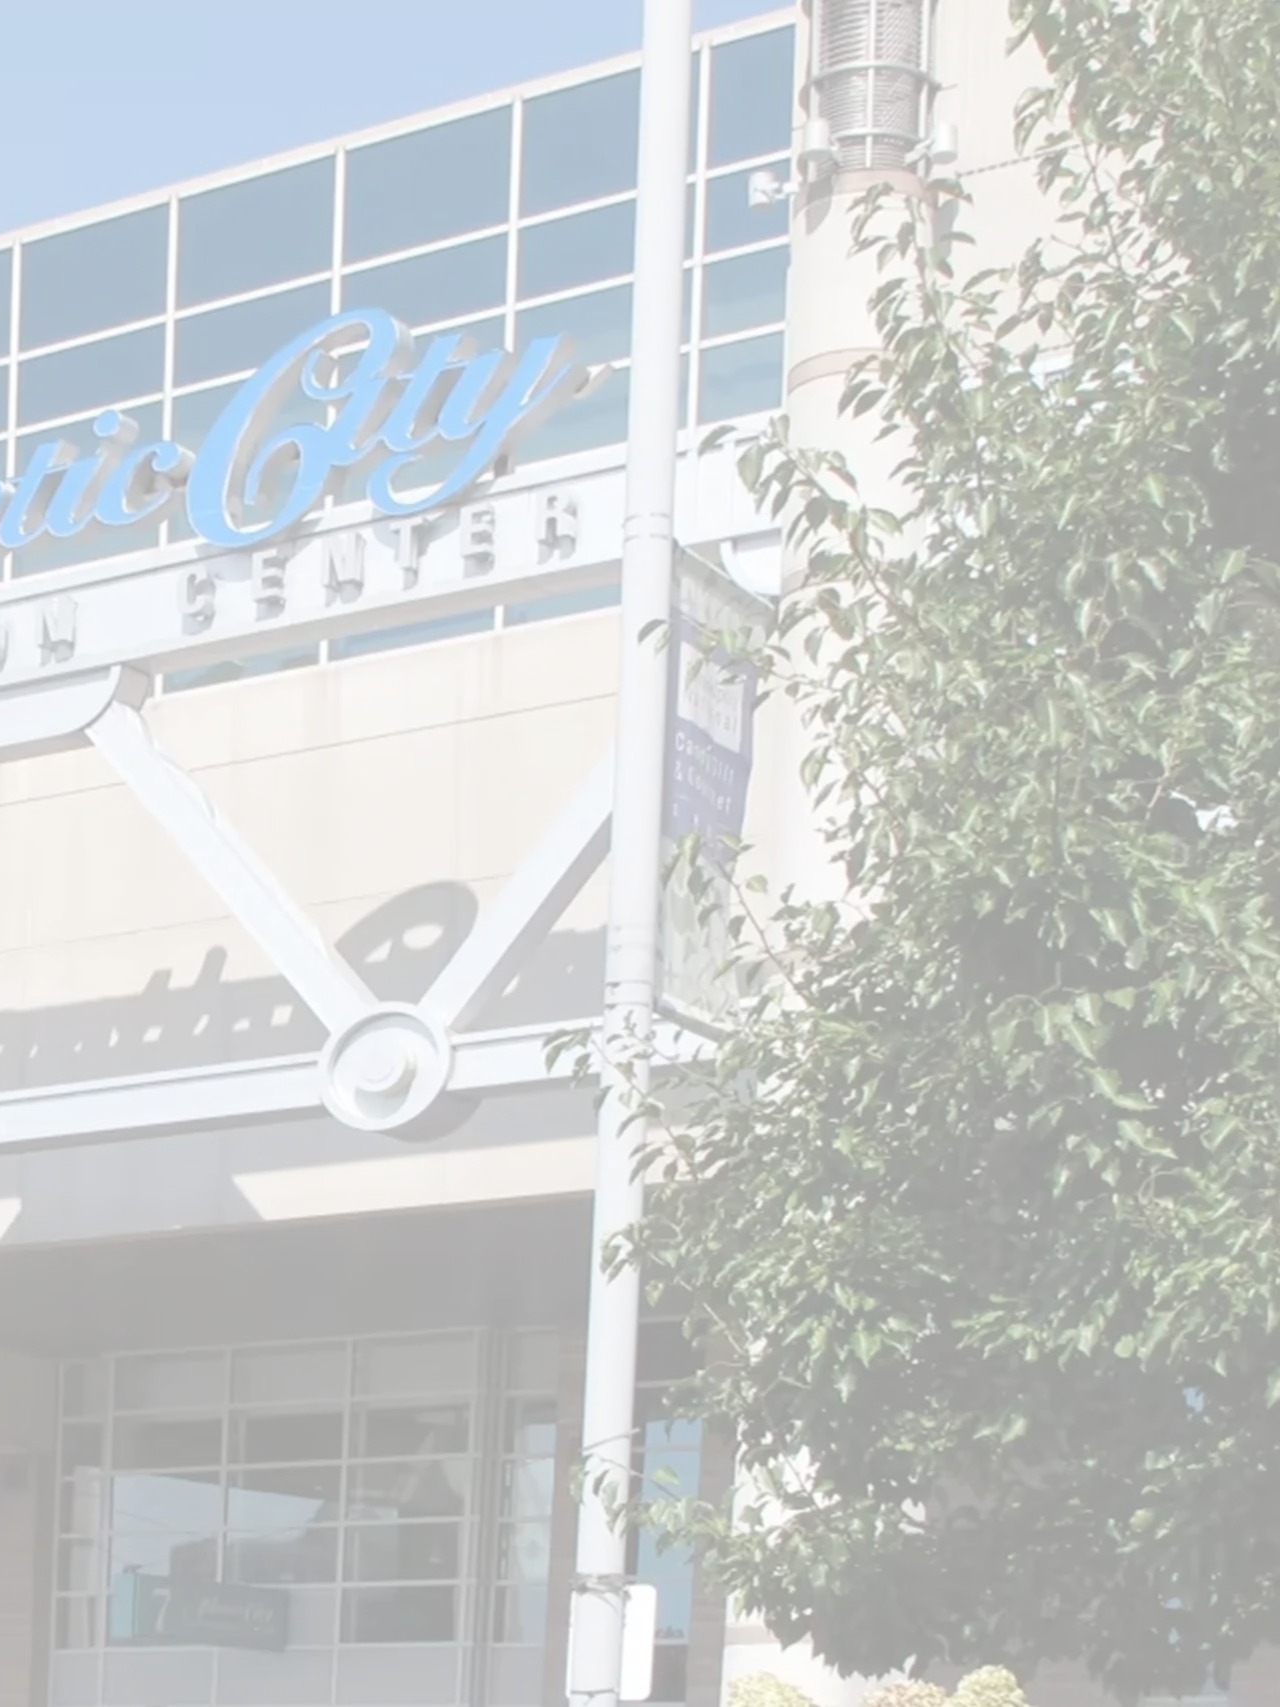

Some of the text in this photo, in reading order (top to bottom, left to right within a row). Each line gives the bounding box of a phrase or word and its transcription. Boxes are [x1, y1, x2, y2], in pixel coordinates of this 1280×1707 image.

[185, 307, 582, 549] City
[174, 488, 583, 626] CENTER
[152, 1587, 172, 1632] 7
